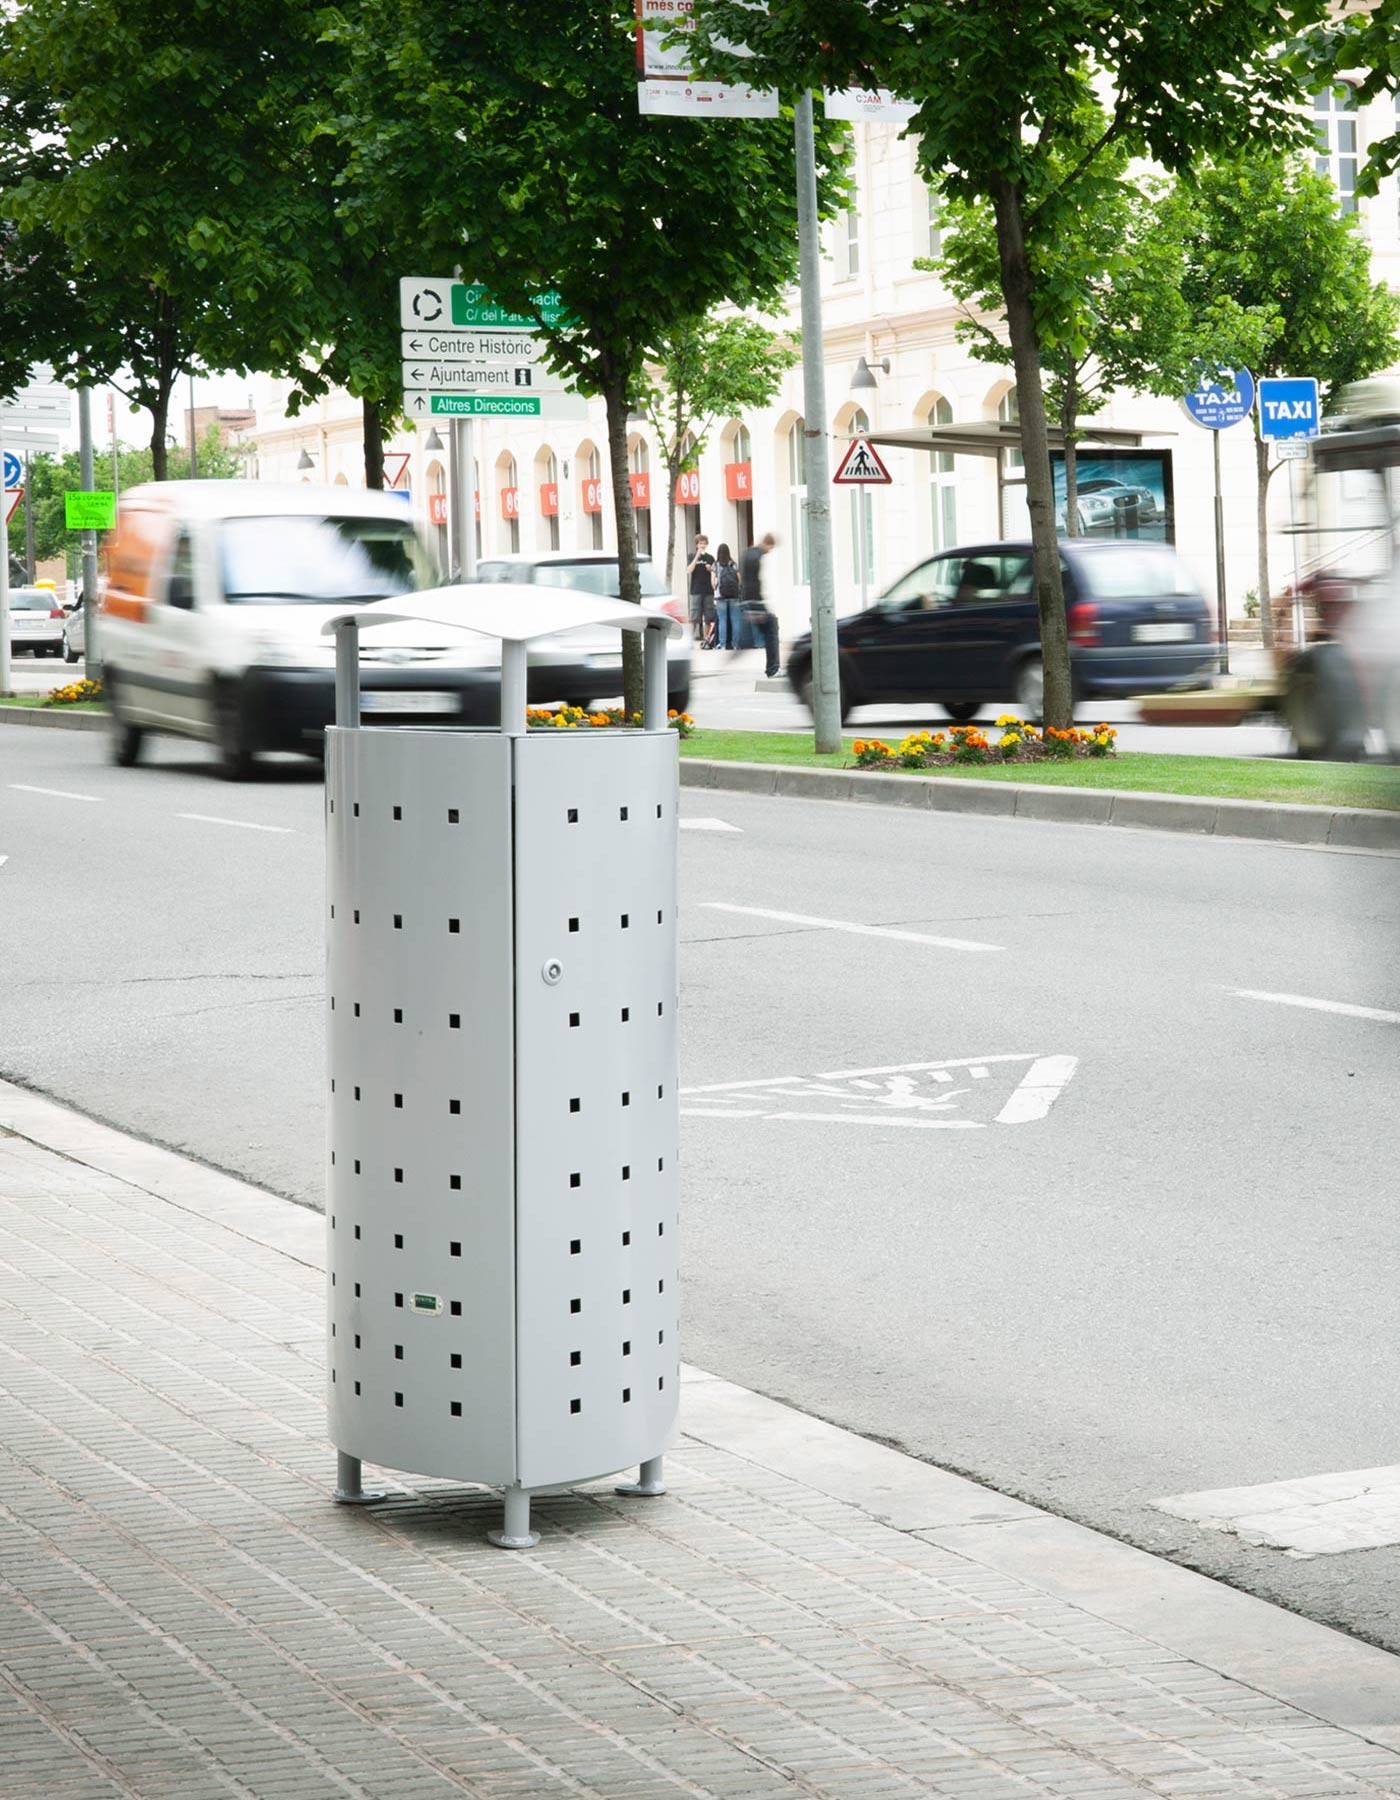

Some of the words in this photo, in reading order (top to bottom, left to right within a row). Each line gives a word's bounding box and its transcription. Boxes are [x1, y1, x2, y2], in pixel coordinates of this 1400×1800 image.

[481, 309, 498, 321] del
[428, 336, 475, 353] Centre
[479, 338, 532, 355] Històric
[430, 365, 509, 385] Ajuntament
[437, 398, 471, 412] Altres
[474, 398, 535, 412] Direccions
[1194, 391, 1242, 406] TAXI
[1264, 400, 1312, 420] TAXI
